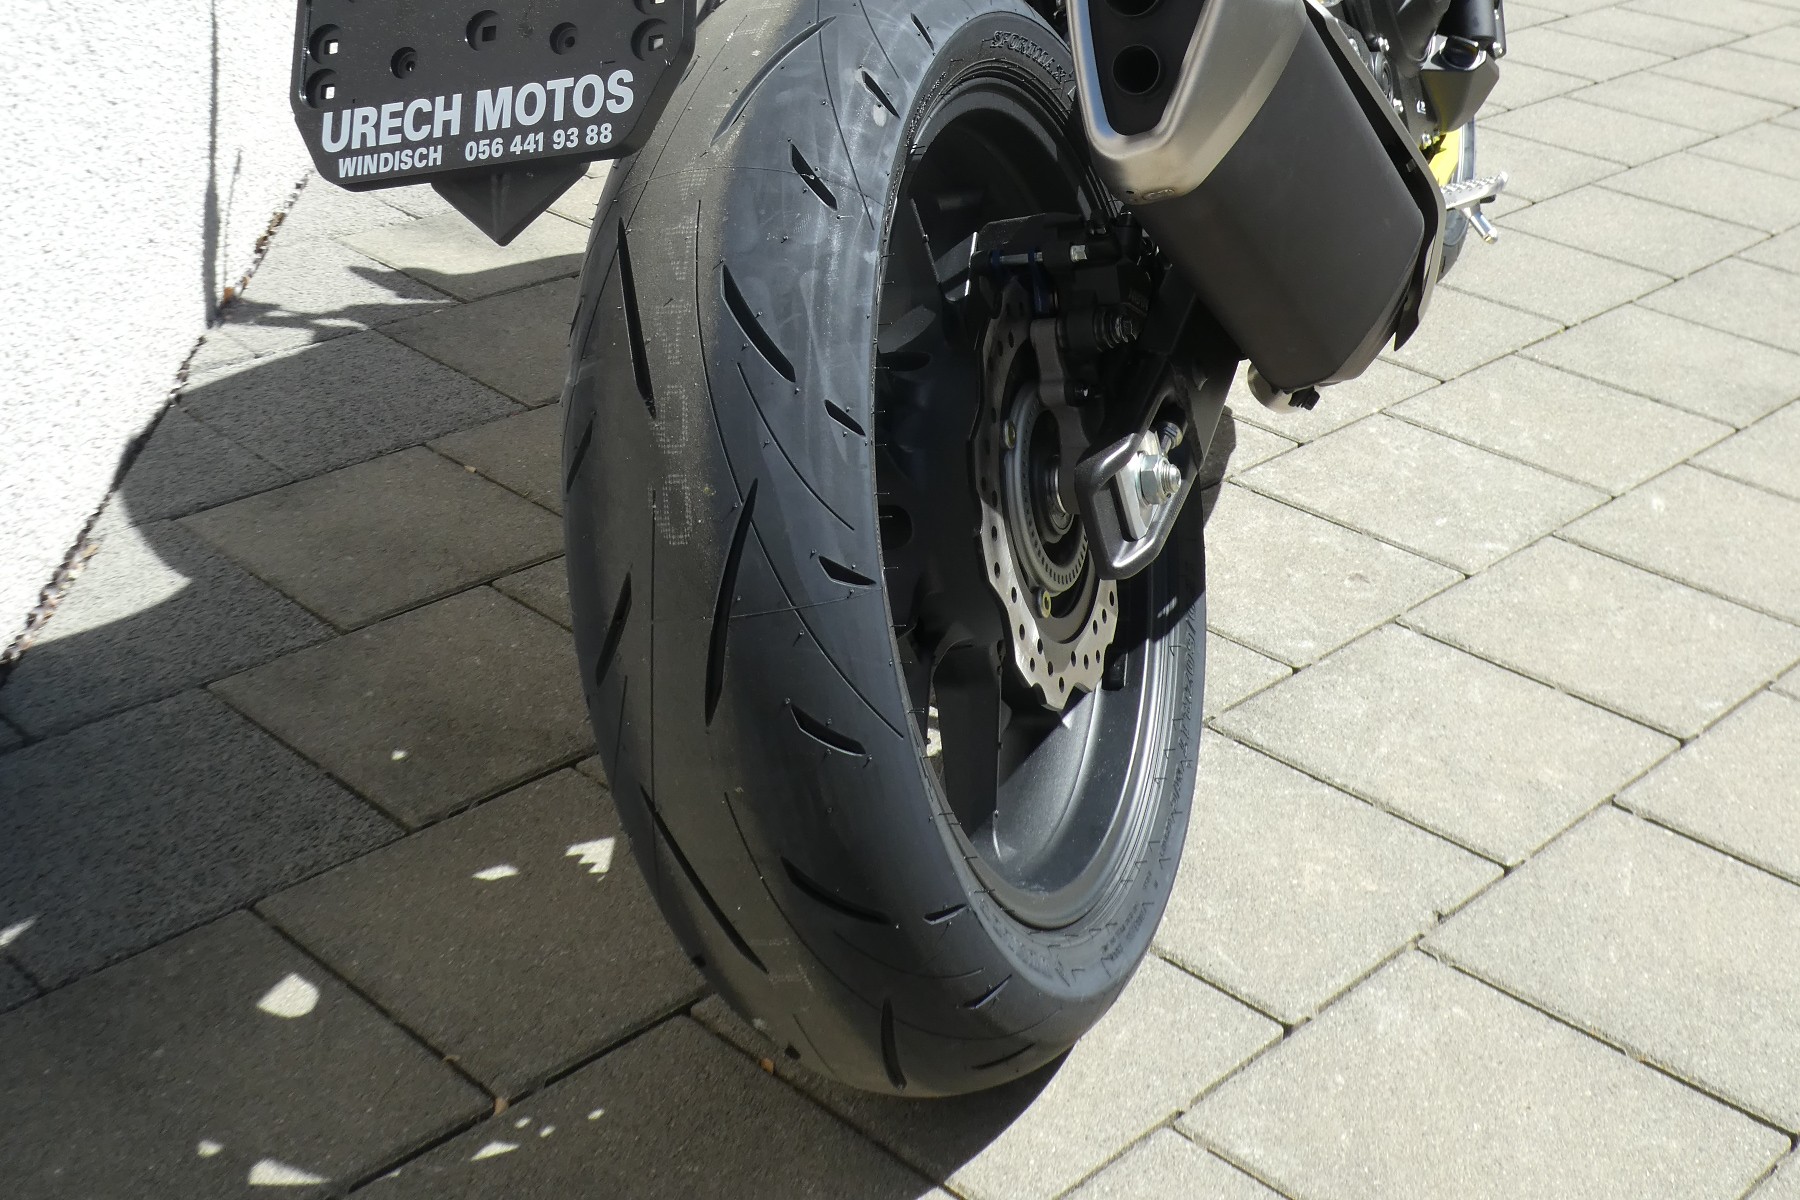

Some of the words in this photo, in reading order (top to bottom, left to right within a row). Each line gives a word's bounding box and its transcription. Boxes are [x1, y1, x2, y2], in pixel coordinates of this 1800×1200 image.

[322, 94, 462, 152] URECH
[475, 70, 634, 132] MOTOS
[338, 145, 442, 178] WINDISCH
[465, 138, 504, 161] 056
[510, 132, 545, 154] 441
[553, 128, 579, 149] 93
[586, 123, 613, 145] 88
